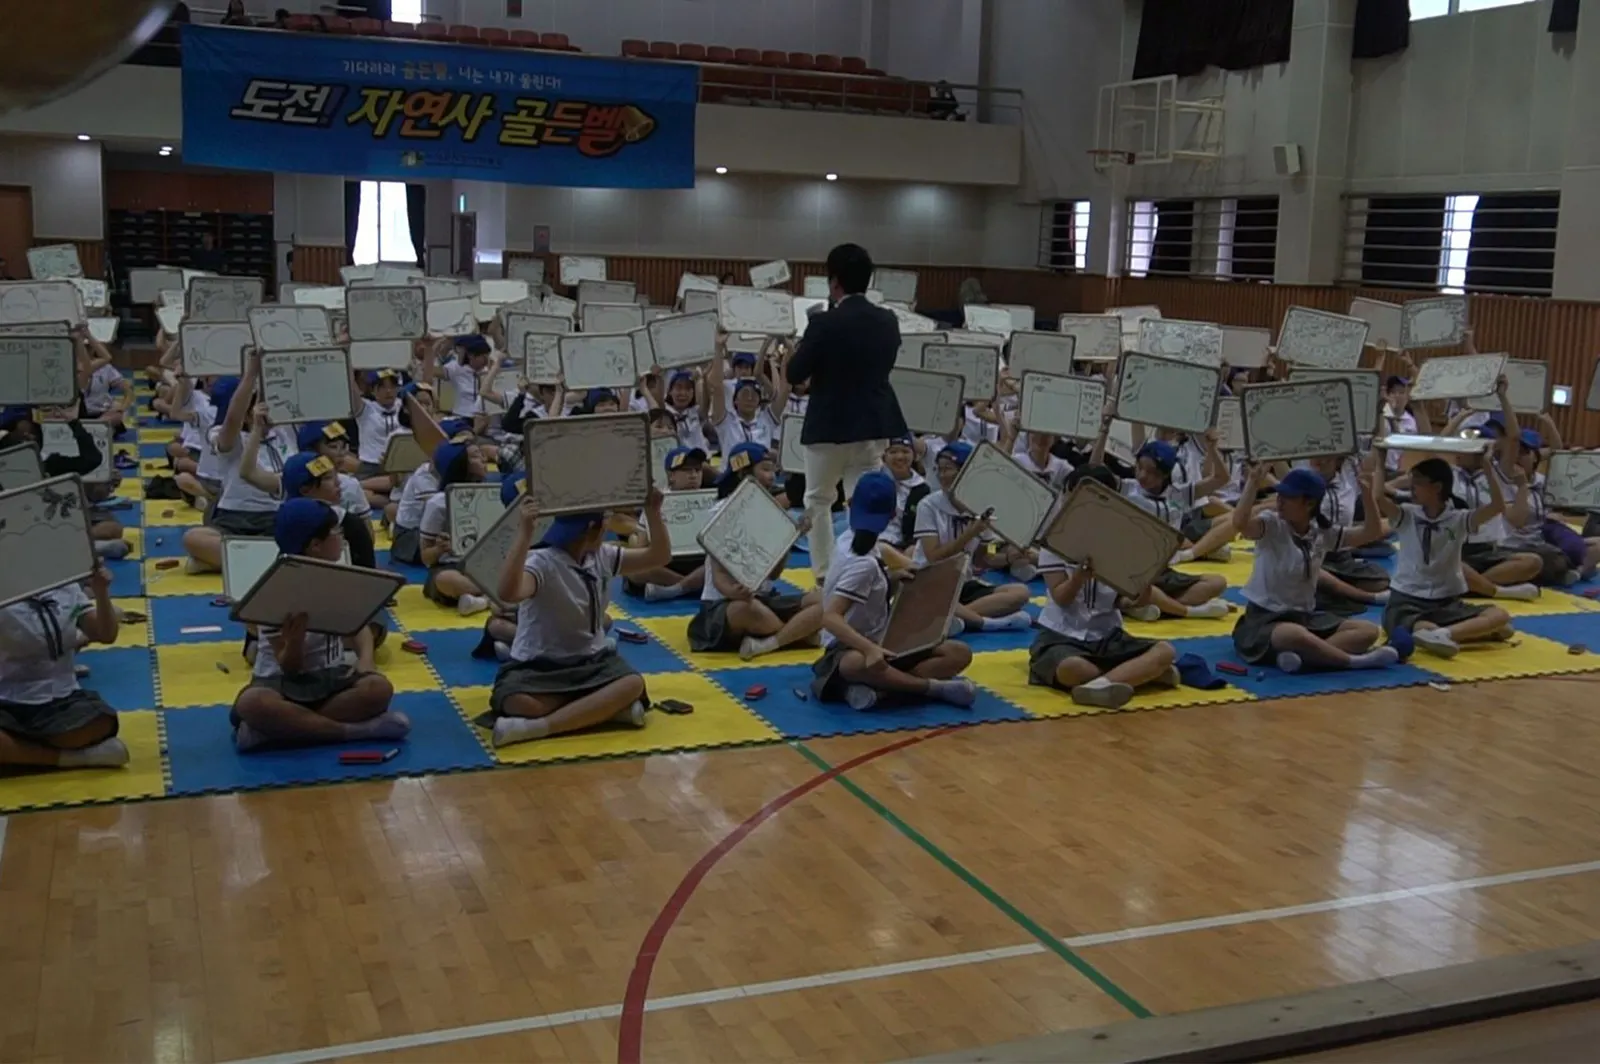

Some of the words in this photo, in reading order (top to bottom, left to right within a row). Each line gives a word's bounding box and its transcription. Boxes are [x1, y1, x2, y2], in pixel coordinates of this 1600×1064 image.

[231, 79, 344, 124] 도전!
[346, 88, 493, 140] 자연사
[499, 98, 622, 156] 골든벨
